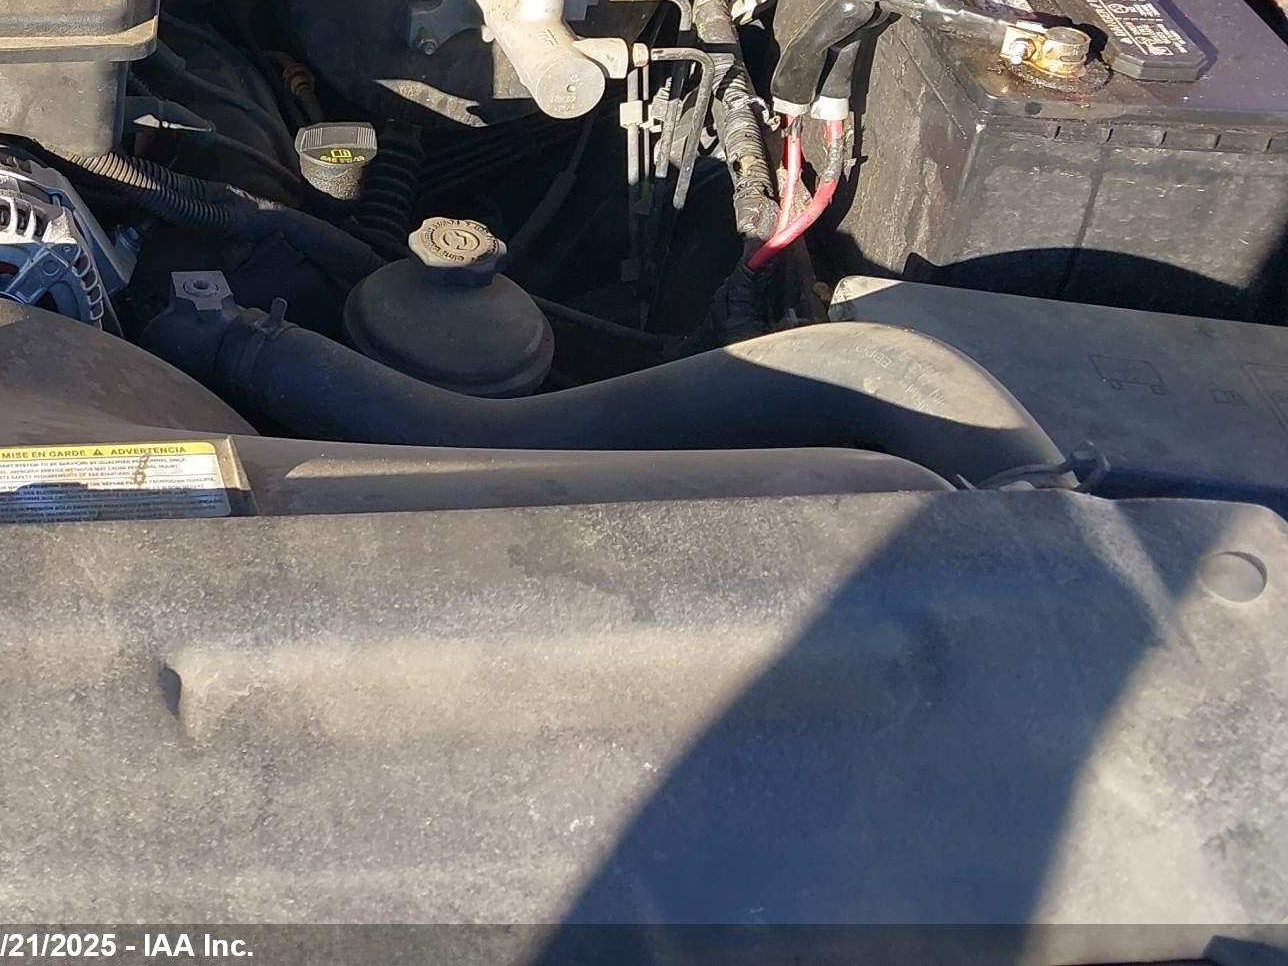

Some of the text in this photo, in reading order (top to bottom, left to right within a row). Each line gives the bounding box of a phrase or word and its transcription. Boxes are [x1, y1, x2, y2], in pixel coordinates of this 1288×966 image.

[2, 451, 29, 459] MISE
[31, 450, 46, 458] EN
[49, 449, 86, 457] GARDE
[110, 446, 187, 455] ADVERTENCIA
